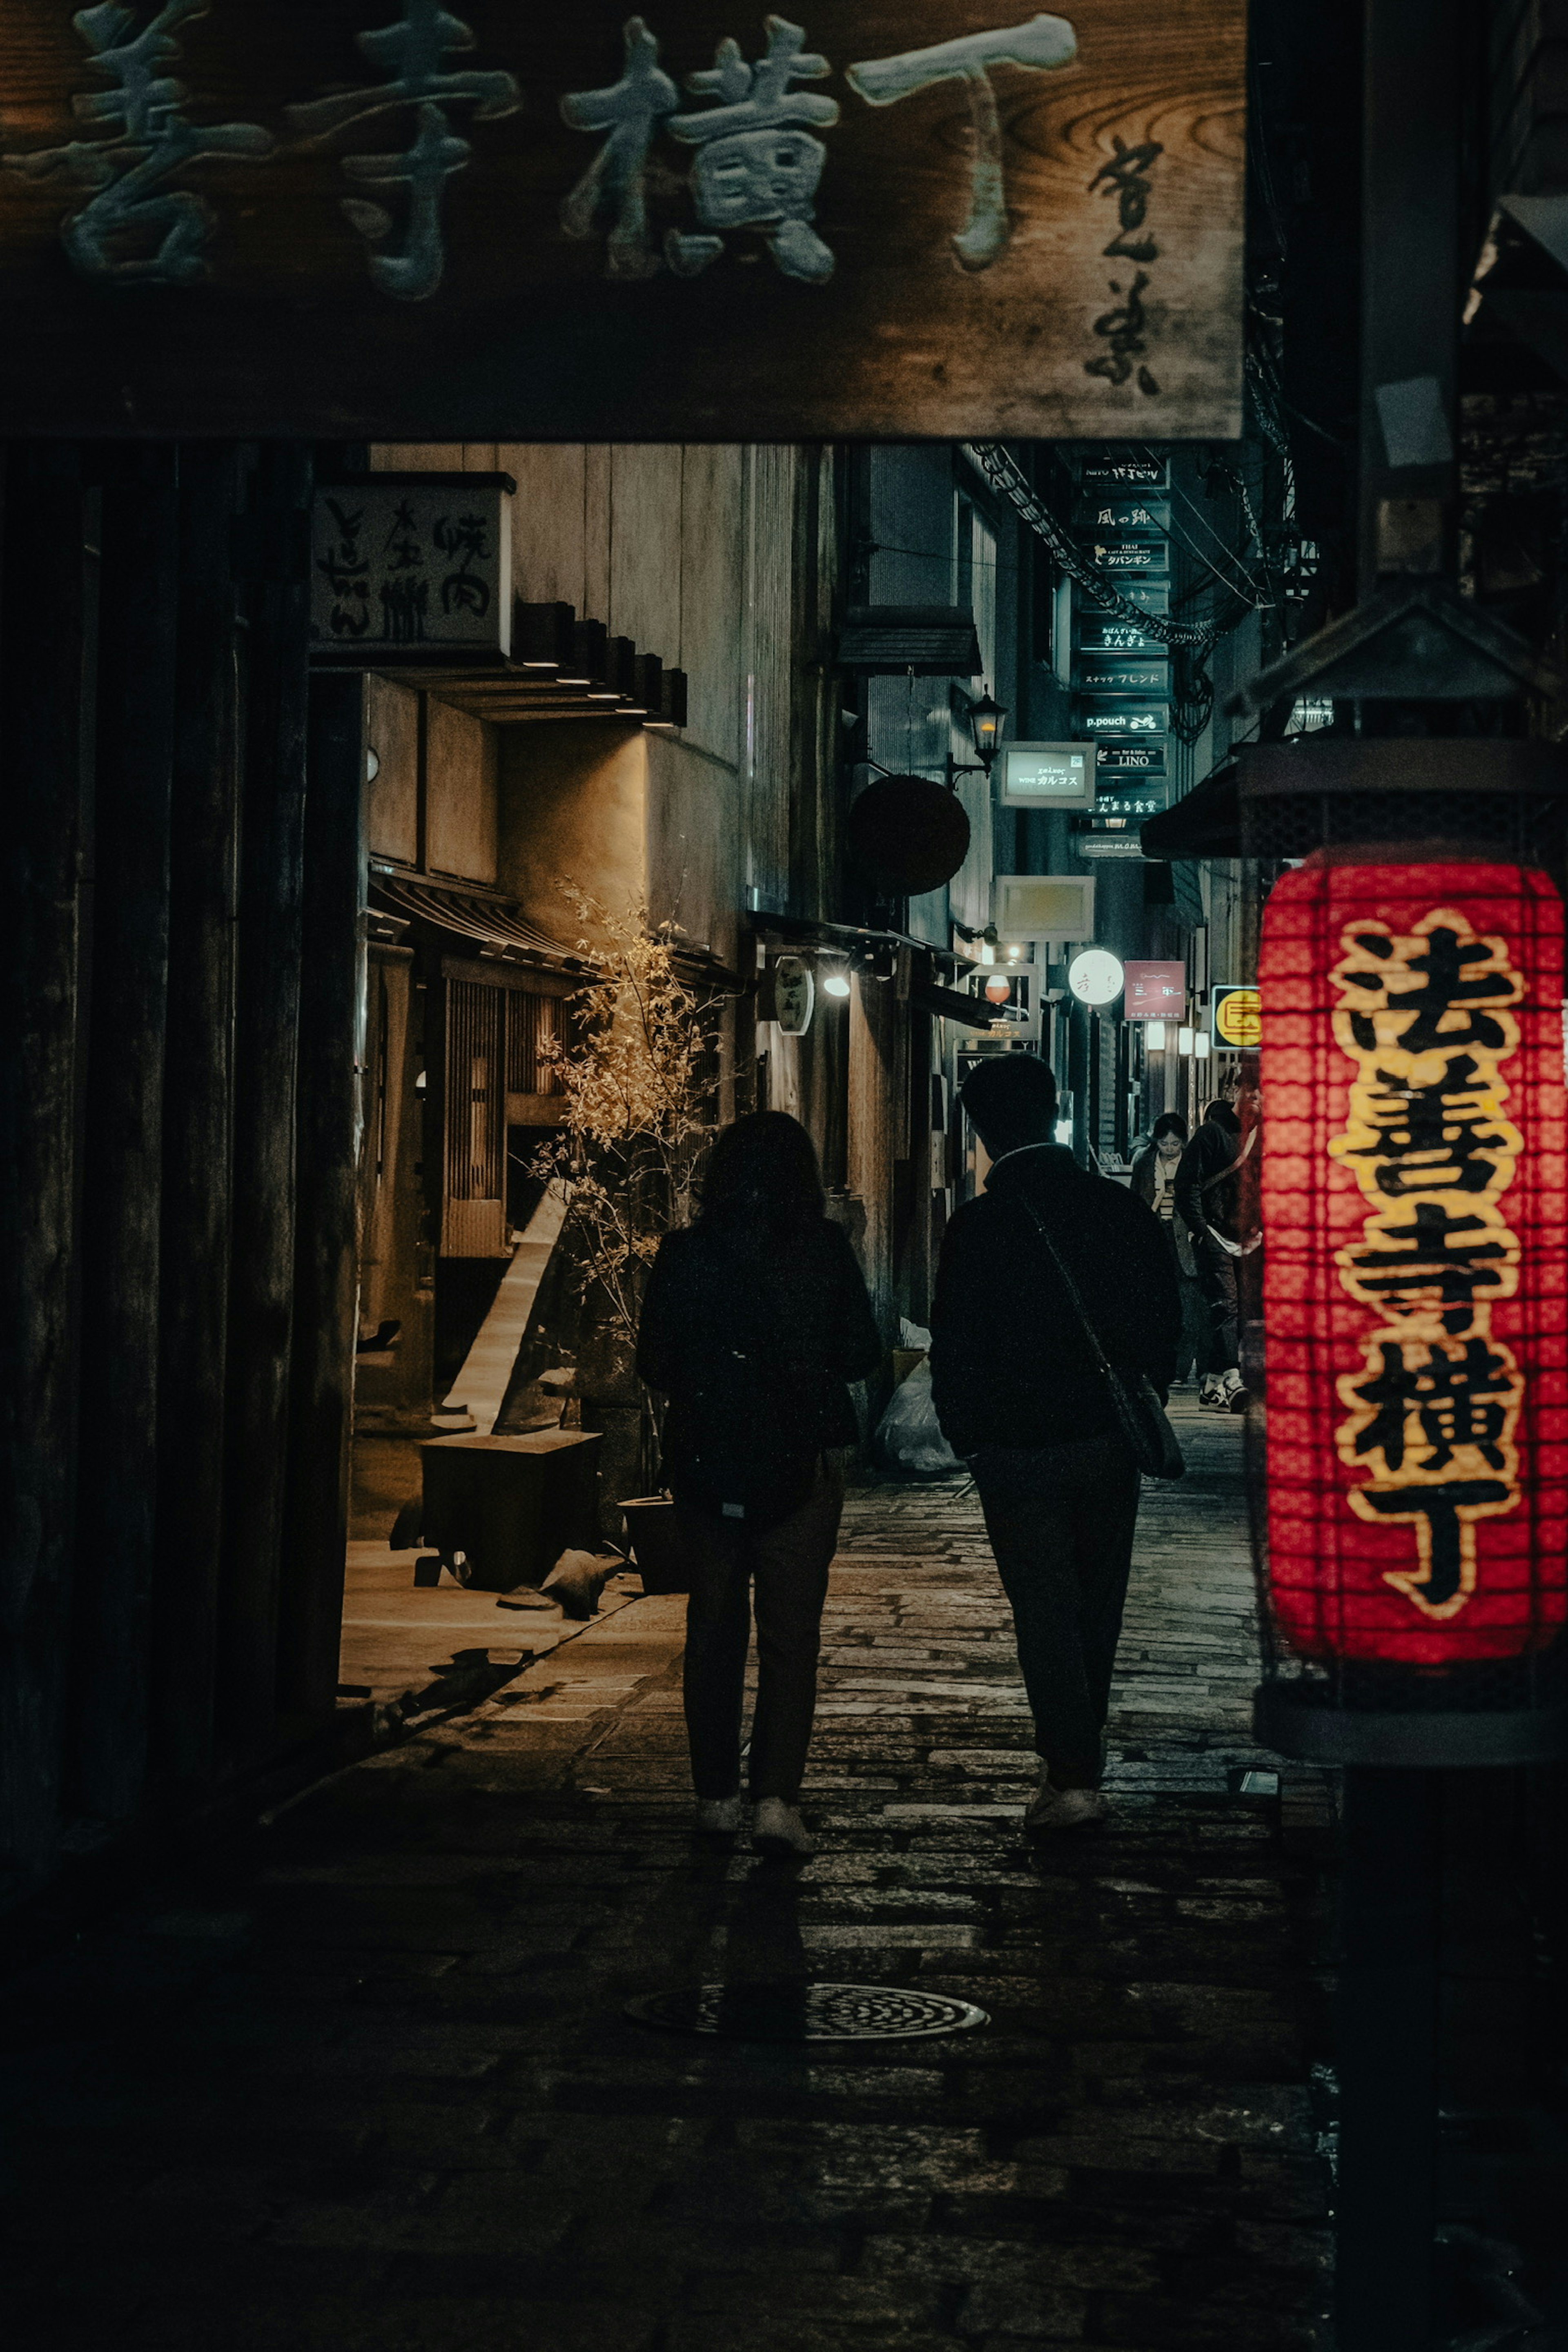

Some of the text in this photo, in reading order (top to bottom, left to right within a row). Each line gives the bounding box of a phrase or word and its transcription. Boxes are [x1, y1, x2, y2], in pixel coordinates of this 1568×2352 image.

[1104, 634, 1145, 647] きんぎょ
[1118, 675, 1159, 684] フレンド
[1086, 716, 1126, 726] p.pouch
[1119, 755, 1149, 766] LINO
[1037, 776, 1078, 786] カルコス
[987, 1030, 1021, 1038] カルコス
[1327, 909, 1527, 1621] 法善寺横丁
